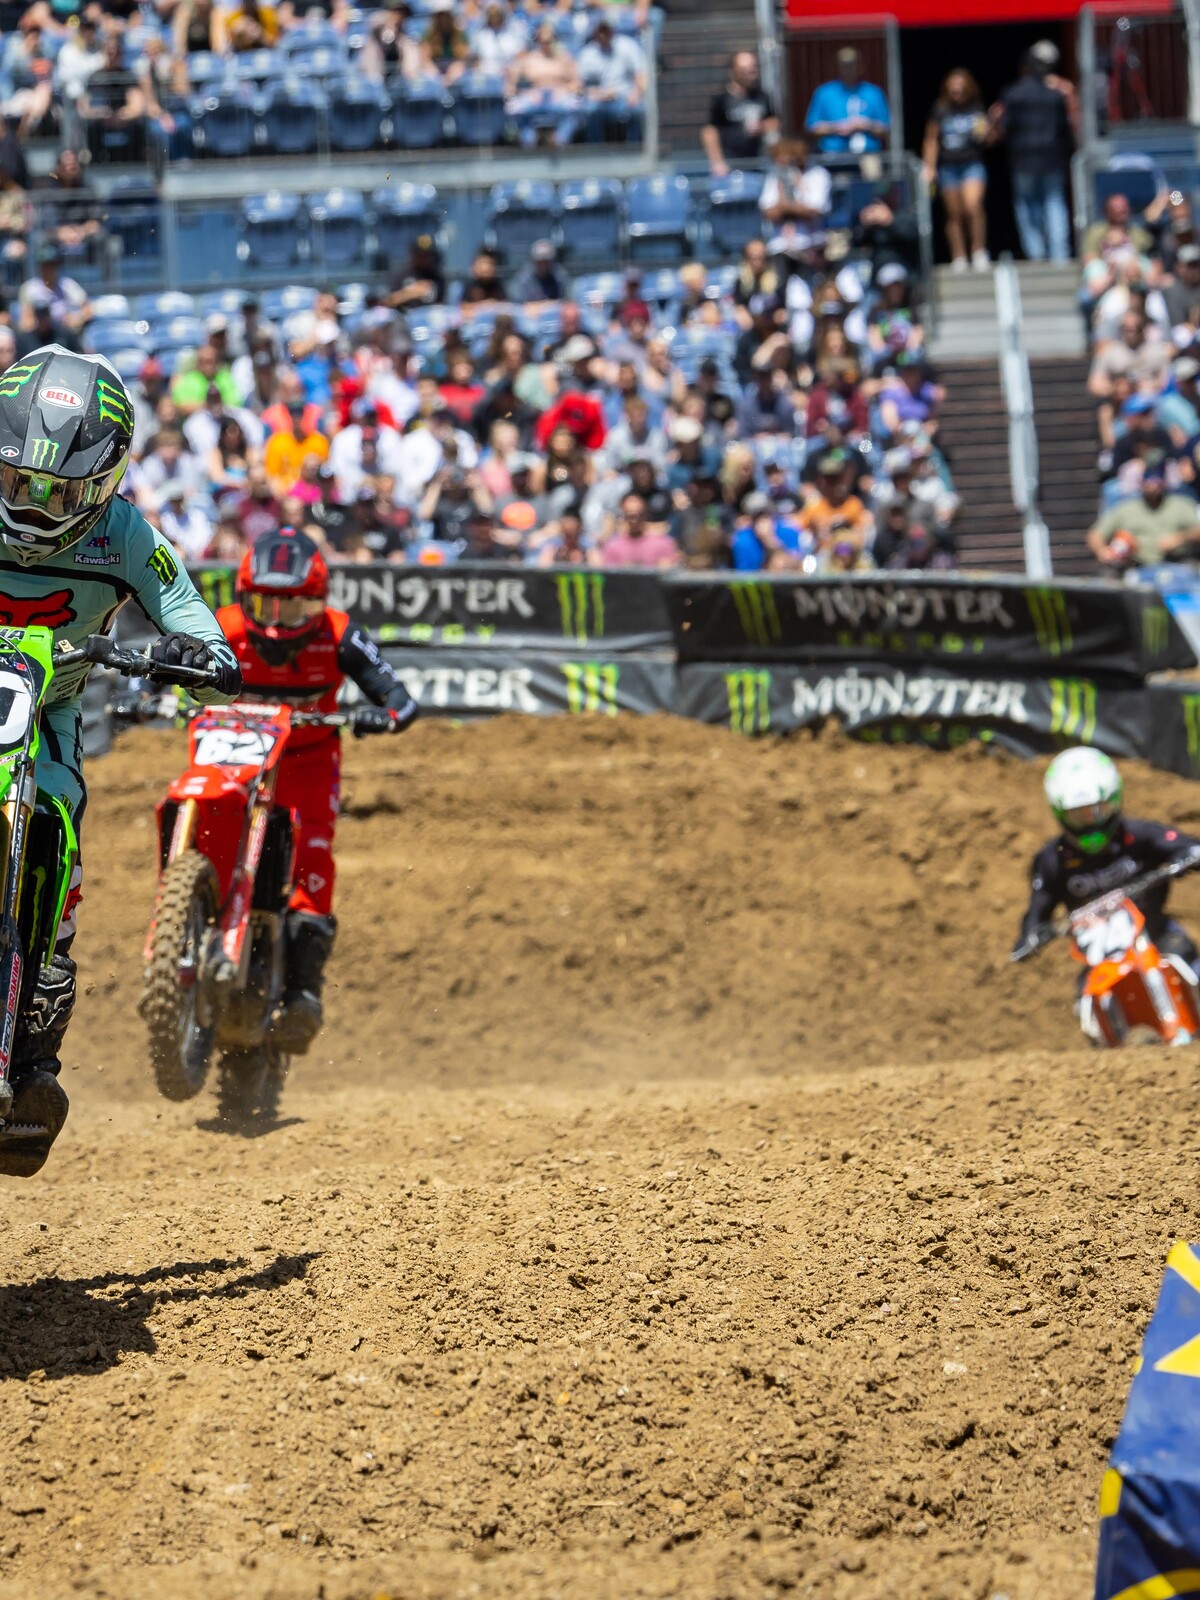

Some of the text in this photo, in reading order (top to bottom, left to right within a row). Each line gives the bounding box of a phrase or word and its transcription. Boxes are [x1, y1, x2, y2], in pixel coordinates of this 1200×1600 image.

[45, 390, 76, 405] BELL
[75, 553, 119, 565] Kawasaki
[329, 570, 535, 619] ONSTER
[793, 584, 1014, 627] MONSTER
[792, 667, 1029, 723] MONSTER
[194, 729, 275, 766] 62
[8, 953, 21, 1014] BRAKING
